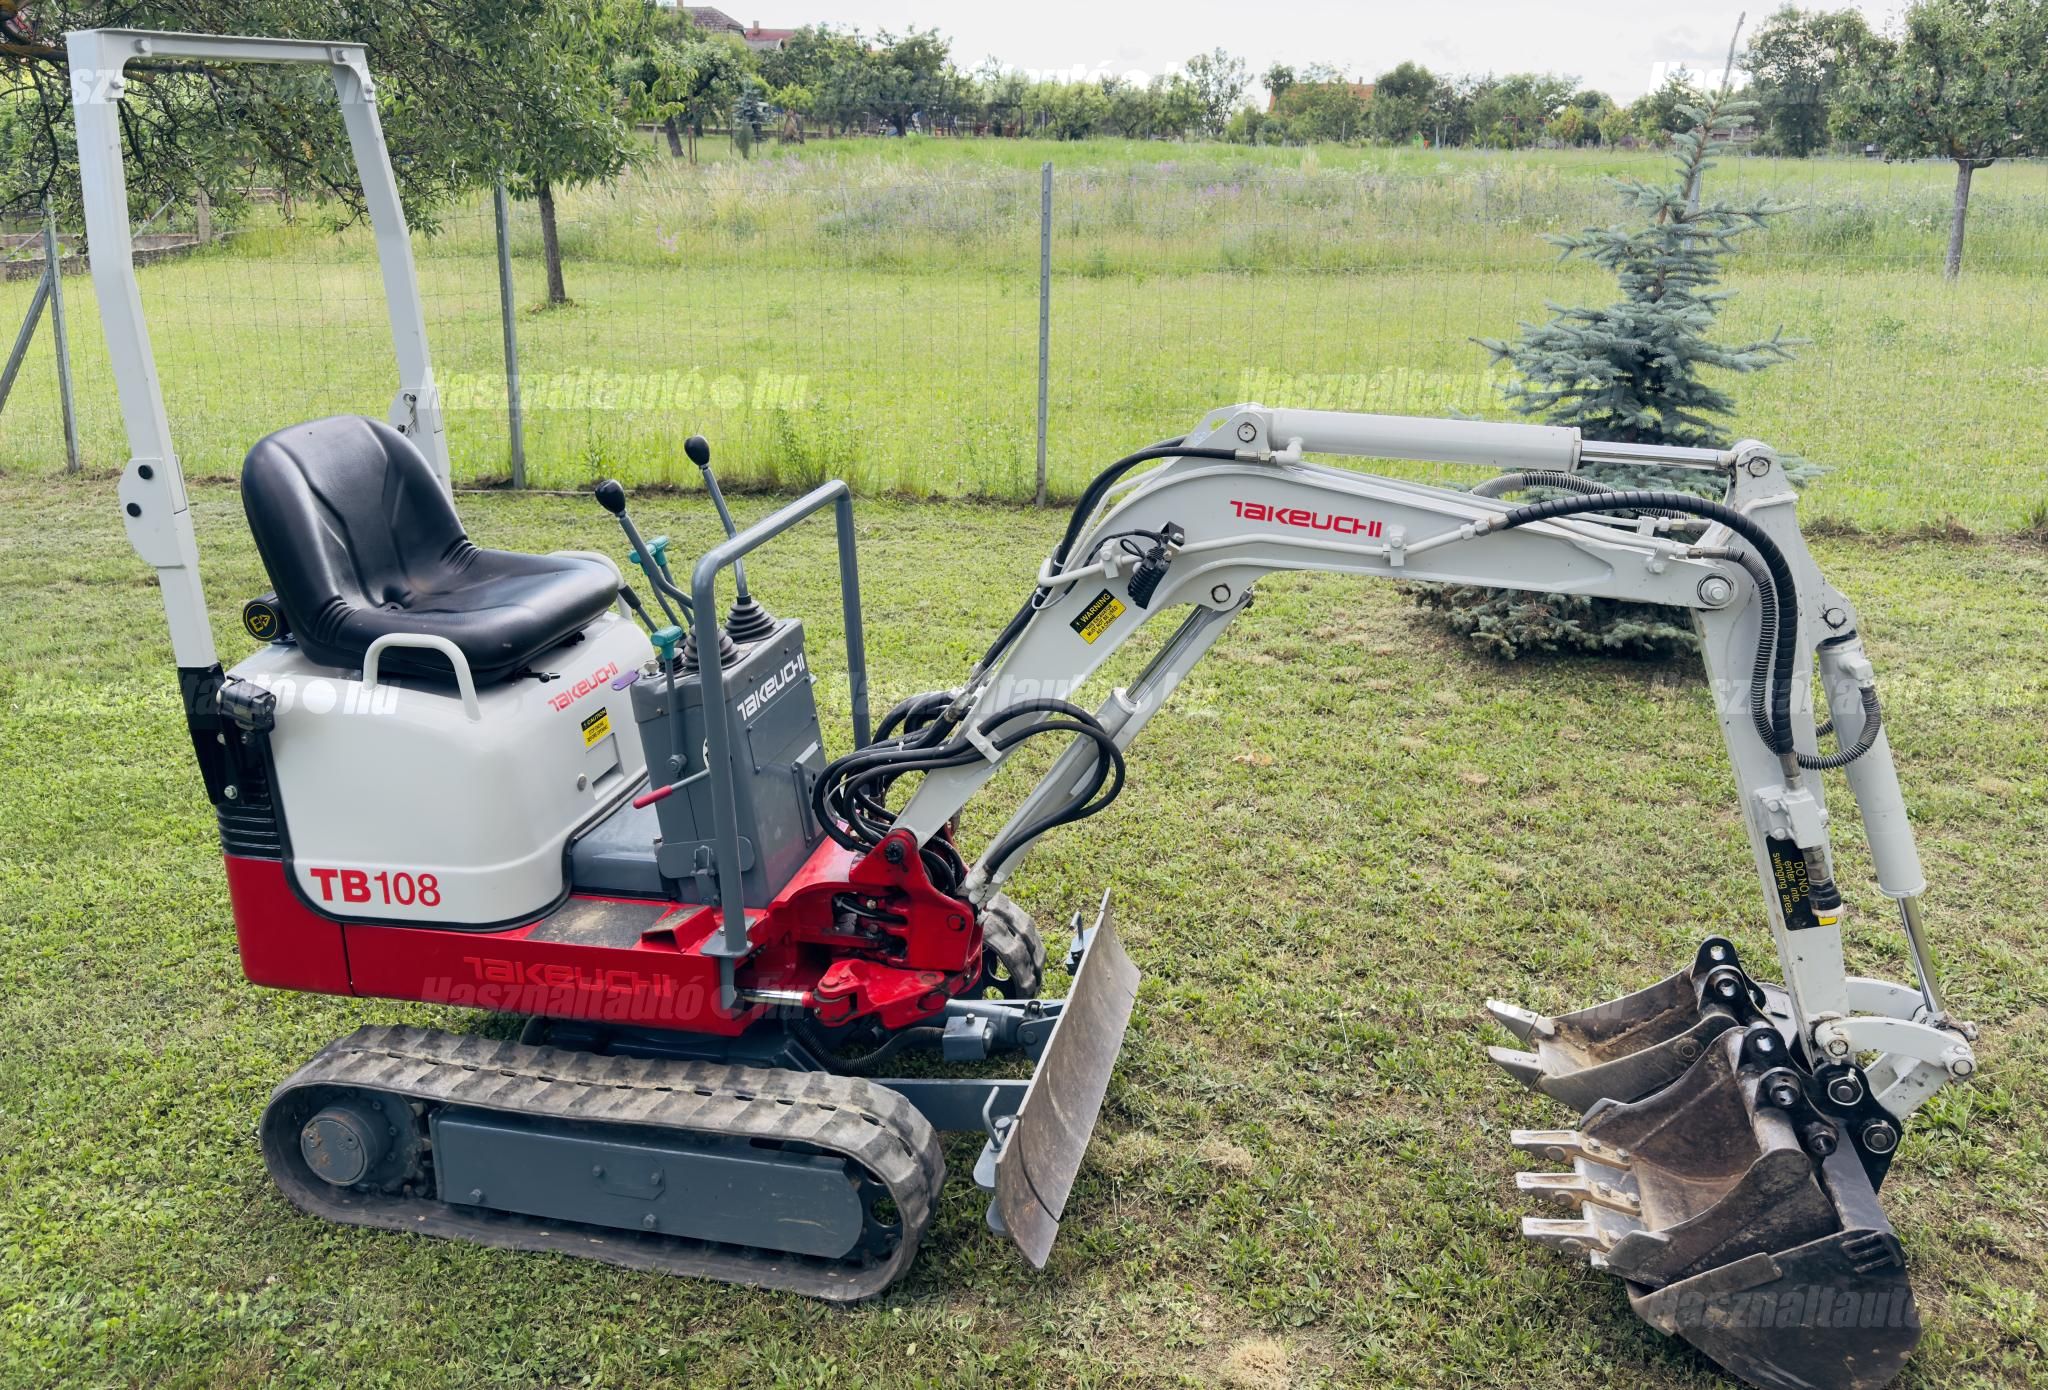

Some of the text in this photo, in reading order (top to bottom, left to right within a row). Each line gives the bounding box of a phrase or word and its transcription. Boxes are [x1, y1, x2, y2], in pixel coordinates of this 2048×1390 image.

[1080, 592, 1111, 623] WARNING
[310, 868, 441, 907] TB108
[1772, 852, 1793, 913] swinging area
[1784, 860, 1800, 902] enter into
[1794, 861, 1806, 876] DO
